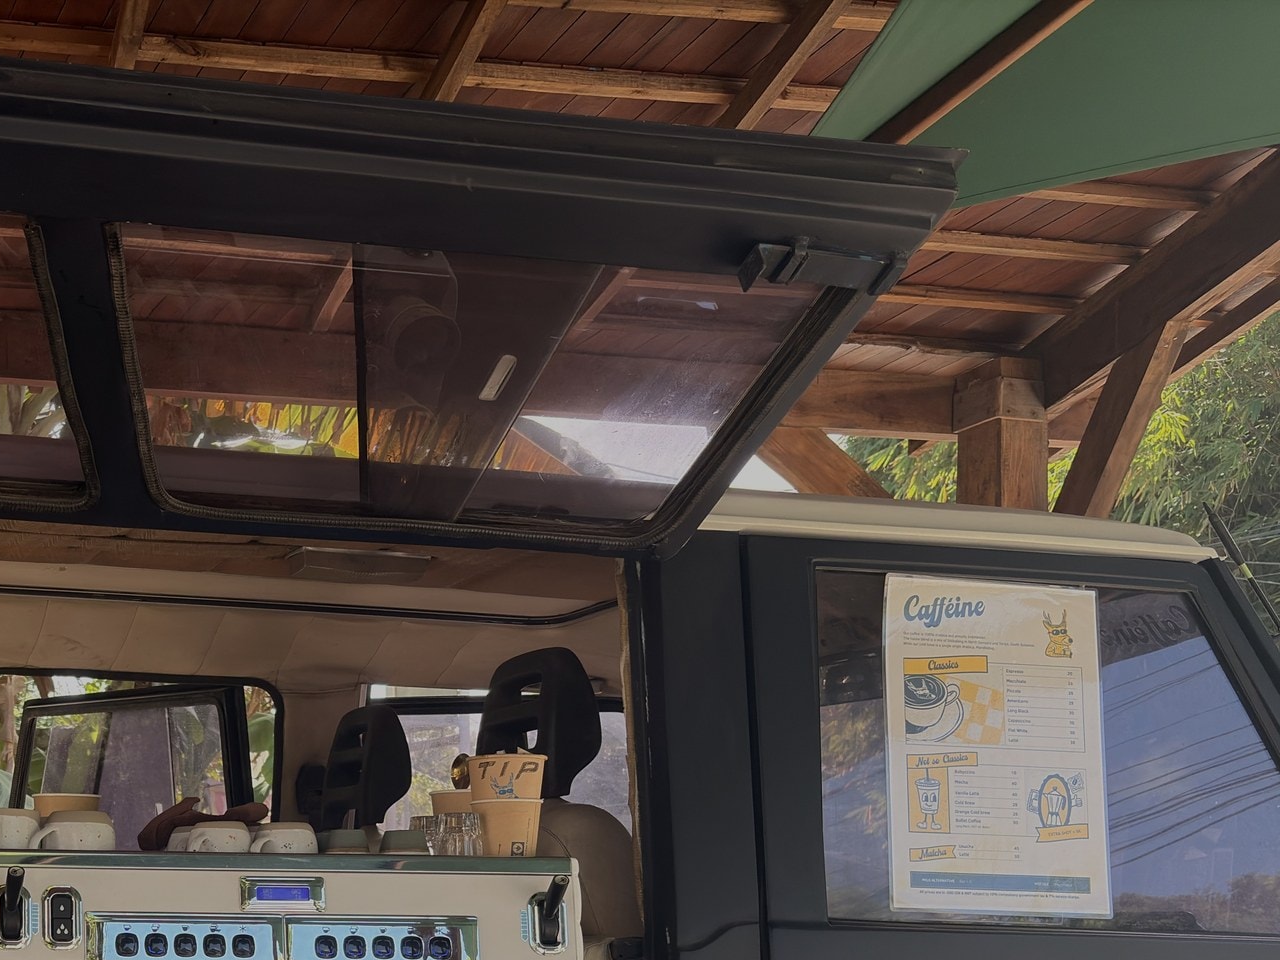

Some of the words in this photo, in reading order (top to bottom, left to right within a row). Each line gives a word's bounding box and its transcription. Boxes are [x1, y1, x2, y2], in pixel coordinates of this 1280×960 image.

[903, 594, 985, 628] Cafféine
[927, 659, 959, 671] Classics
[915, 756, 930, 767] Not
[942, 754, 968, 763] Classics
[478, 760, 540, 780] TIP
[918, 849, 947, 860] Matcha
